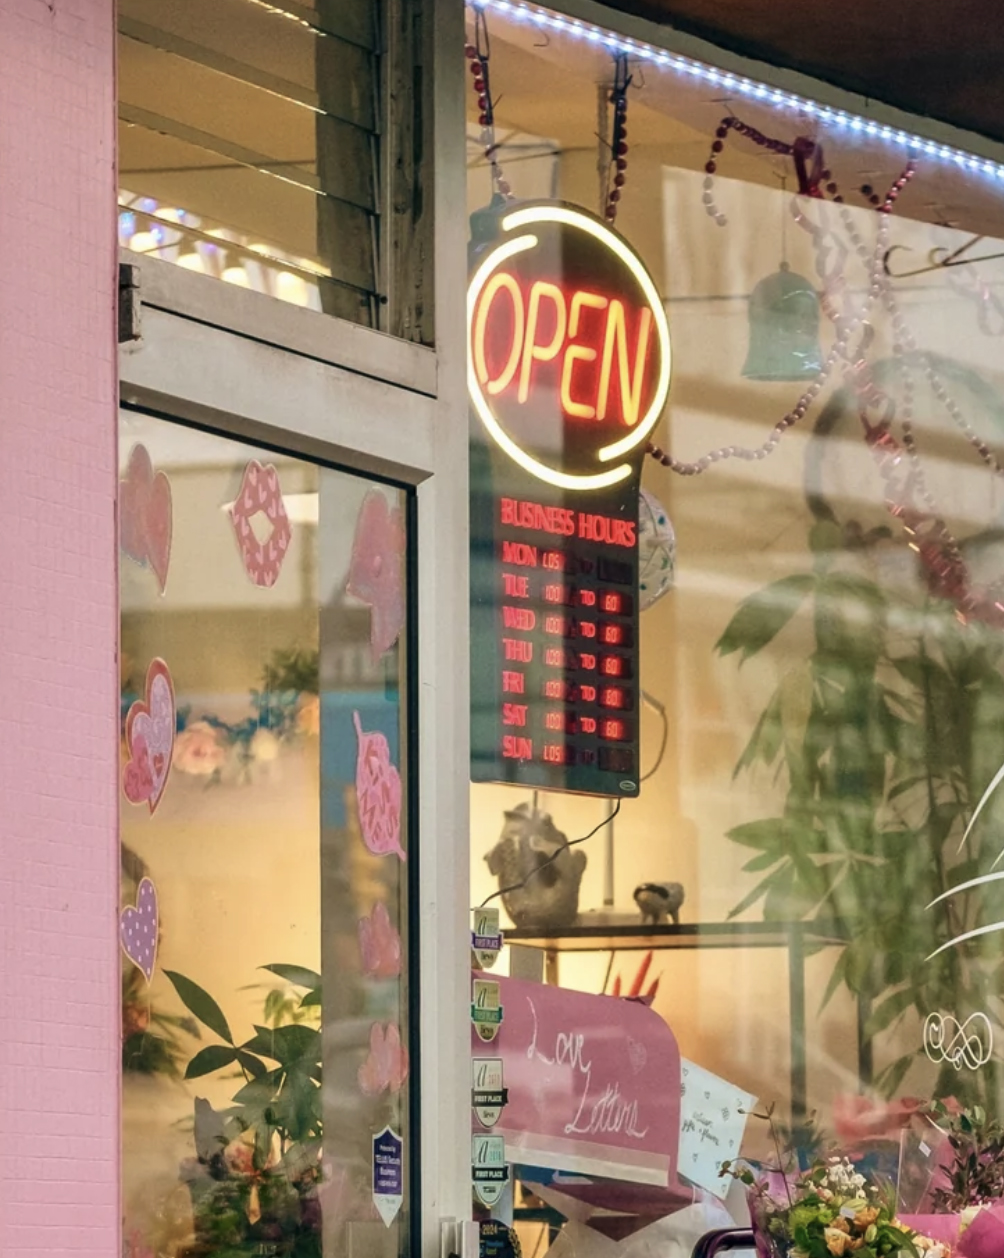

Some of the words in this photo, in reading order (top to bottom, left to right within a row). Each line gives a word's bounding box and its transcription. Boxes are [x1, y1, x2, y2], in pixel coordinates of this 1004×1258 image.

[473, 272, 652, 427] OPEN
[501, 497, 575, 536] BUSINESS
[578, 513, 636, 547] HOURS
[503, 541, 537, 567] MON
[502, 573, 529, 598] TUE
[502, 606, 536, 631] WED
[502, 638, 533, 662] THU
[502, 670, 525, 694] FRI
[502, 703, 528, 727] SAT
[502, 735, 532, 760] SUN
[526, 996, 592, 1073] Love
[474, 1095, 487, 1104] FIRST
[488, 1095, 502, 1104] PLACE
[564, 1070, 649, 1138] Letters
[475, 1170, 488, 1179] FIRST
[489, 1170, 504, 1179] PLACE
